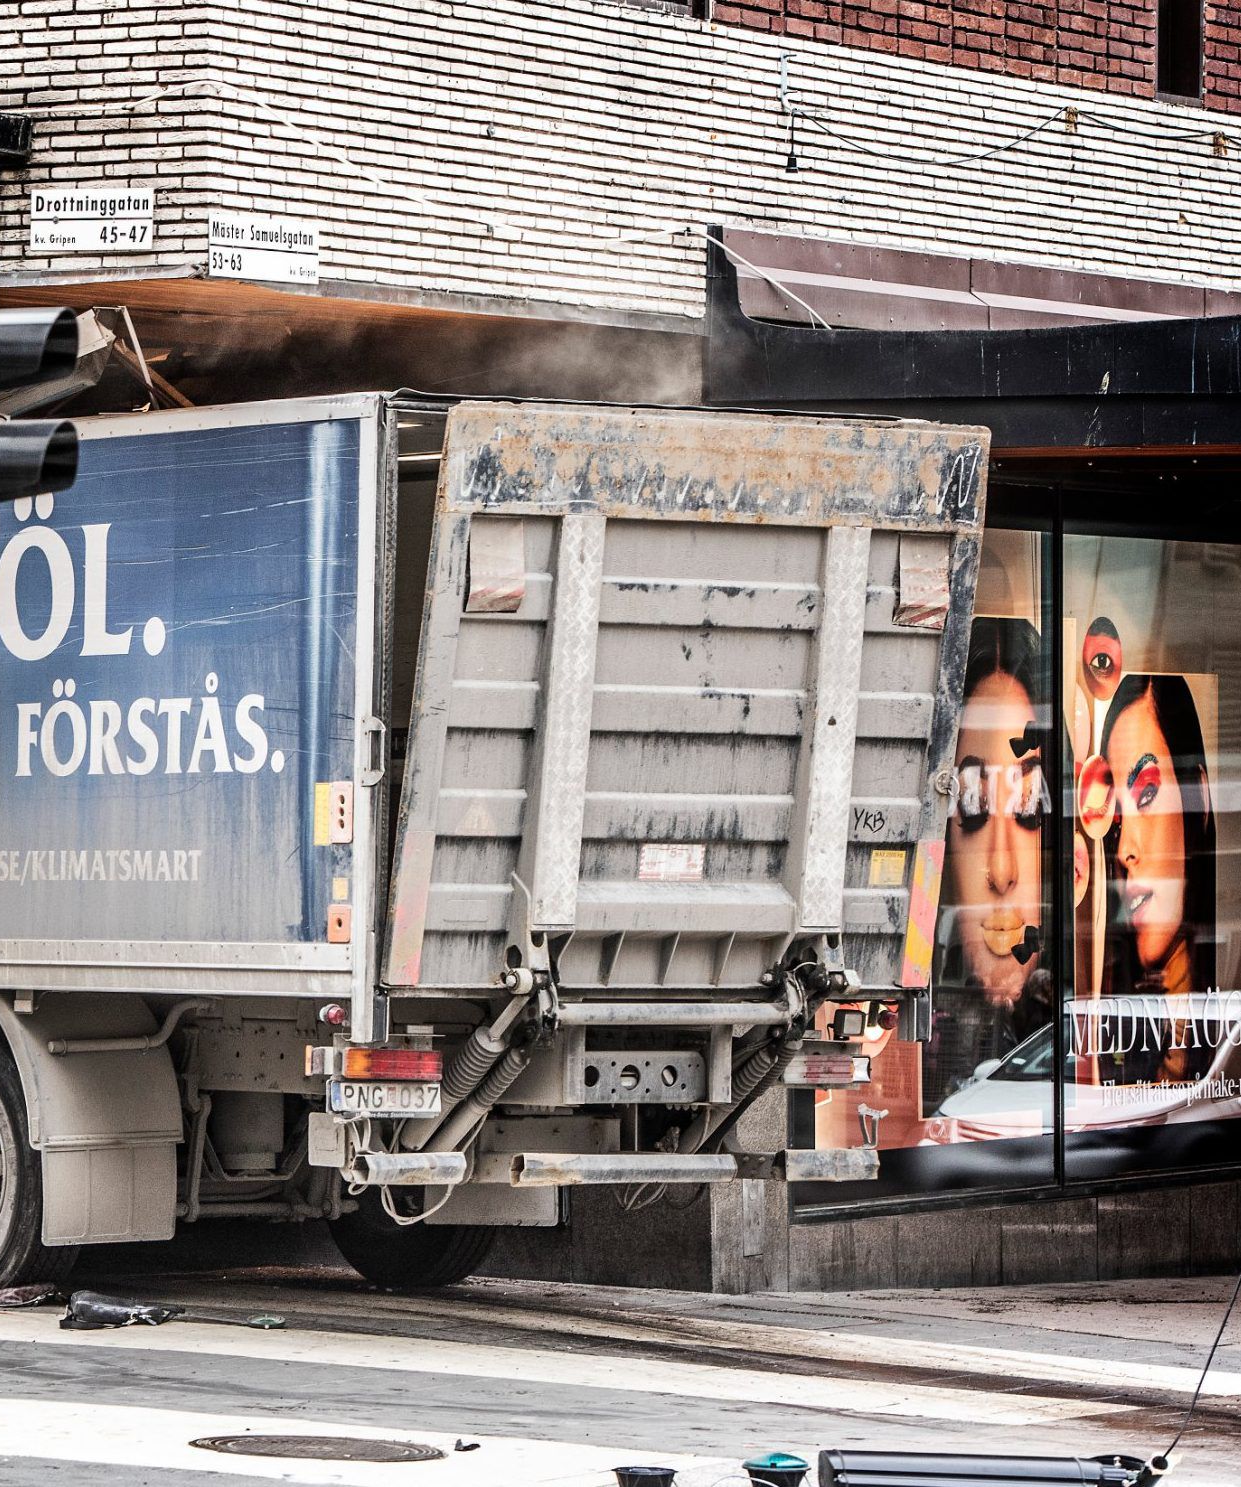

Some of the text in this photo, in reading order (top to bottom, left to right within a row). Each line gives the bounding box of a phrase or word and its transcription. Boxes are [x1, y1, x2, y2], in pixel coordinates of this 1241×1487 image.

[35, 195, 150, 216] Drottninggatan
[35, 234, 76, 246] kv. Gripen
[99, 226, 147, 243] 45-47
[213, 221, 313, 249] Mäster Samuelsgatan
[212, 253, 242, 271] 53-63
[15, 672, 286, 778] FÖRSTÅS.
[854, 807, 885, 833] YKB
[1065, 998, 1136, 1057] MED
[1140, 995, 1202, 1053] NYA
[344, 1085, 439, 1109] PNG 037
[1205, 1071, 1241, 1099] make-
